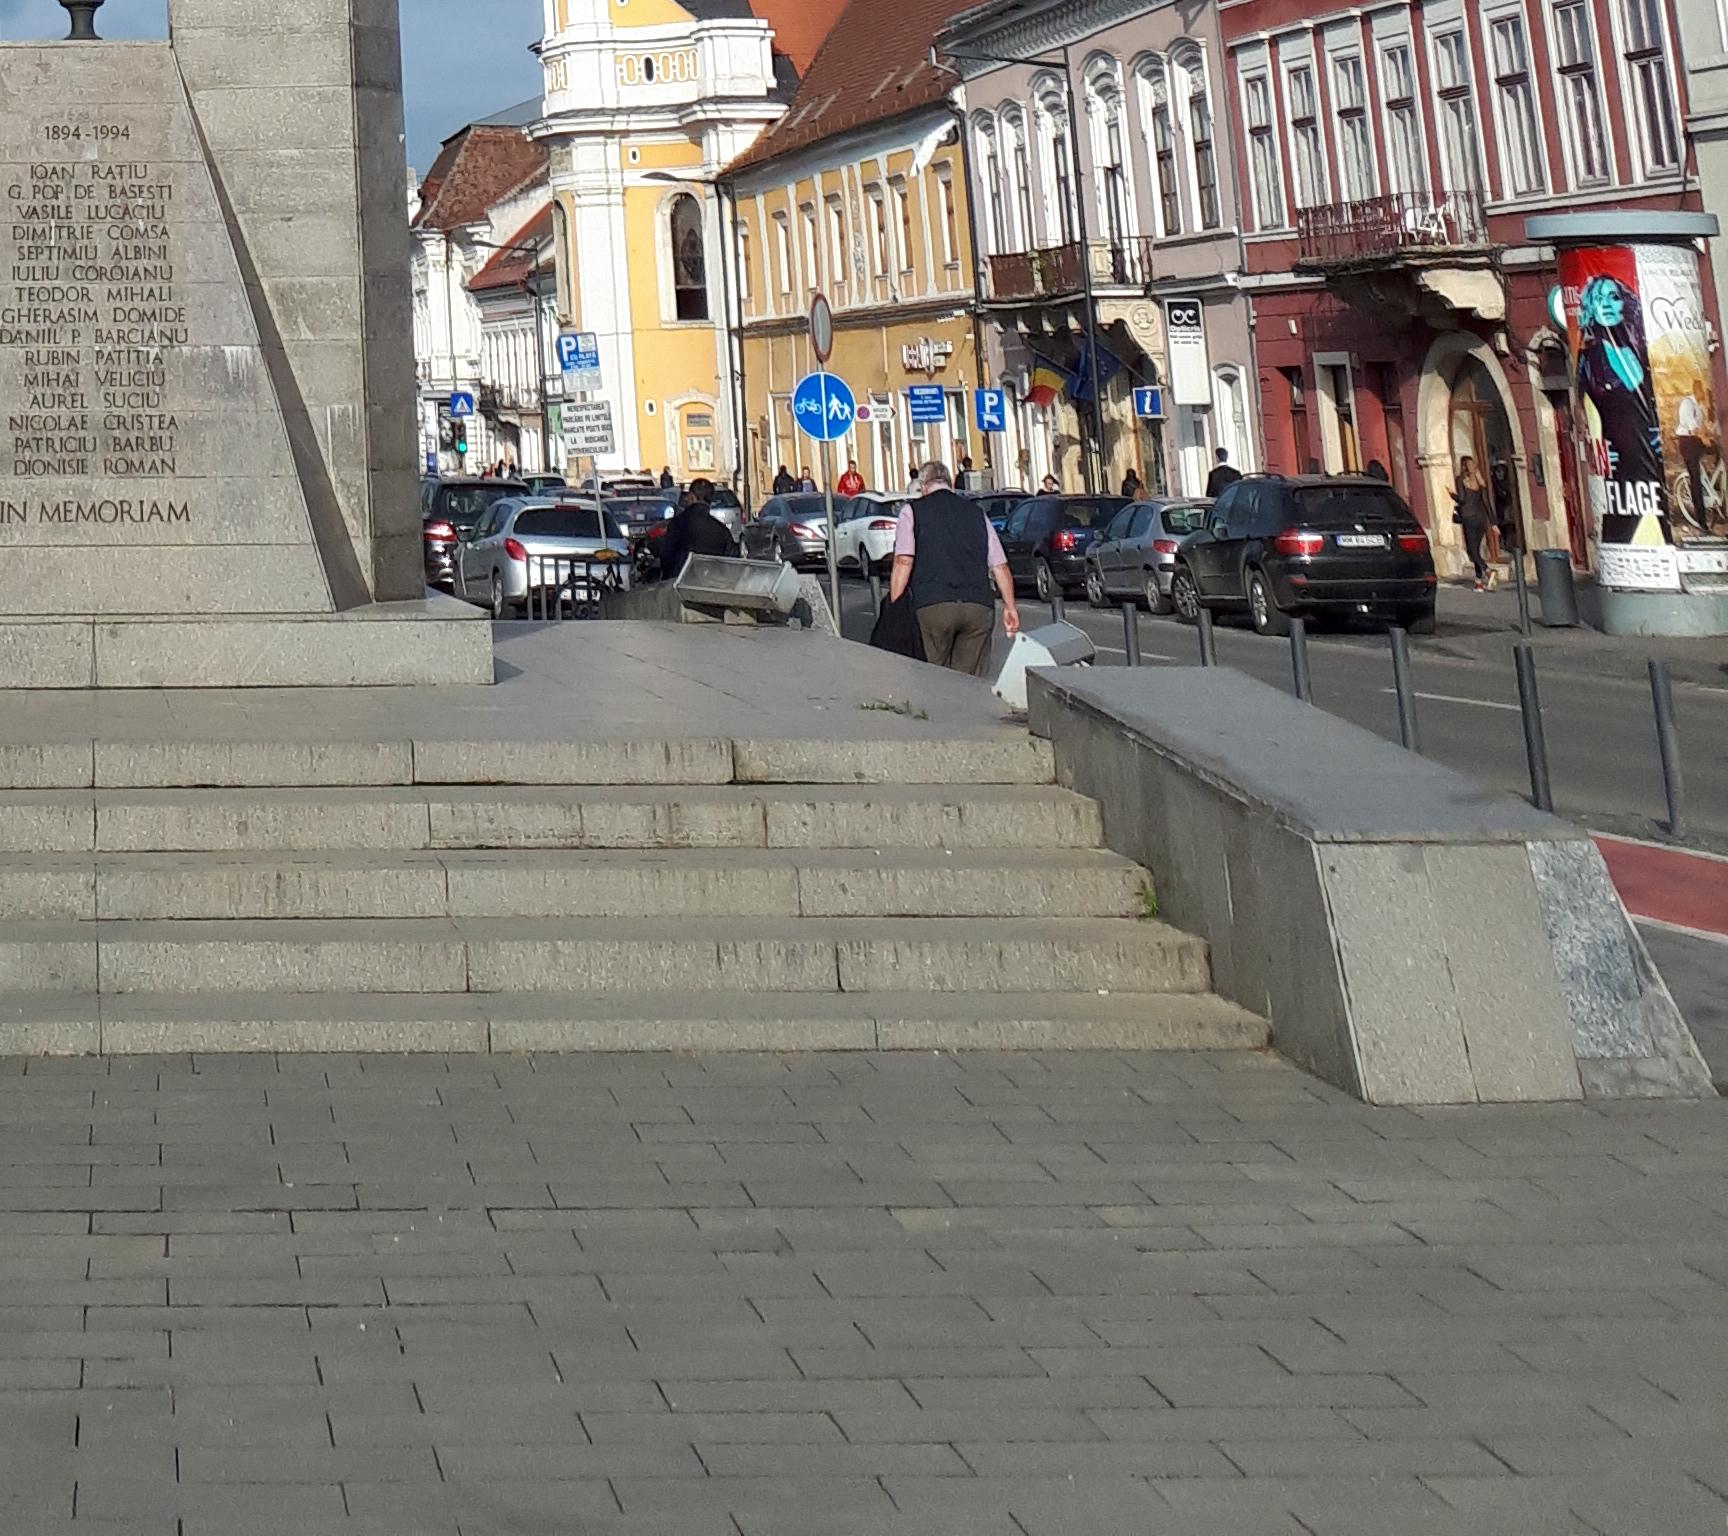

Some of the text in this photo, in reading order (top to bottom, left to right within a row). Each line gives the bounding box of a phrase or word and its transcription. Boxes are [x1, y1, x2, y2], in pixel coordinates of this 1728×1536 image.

[30, 163, 76, 180] IOAN
[74, 184, 95, 200] DE
[16, 204, 165, 220] VASILE LUCACIU
[12, 225, 94, 241] DIMITRIE
[17, 244, 167, 261] SEPTIMIU ALBINI
[12, 264, 173, 281] IULIU COROIANU
[15, 286, 172, 303] TEODOR MIHALI
[1, 307, 187, 324] GHERASIM DOMIDE
[0, 328, 60, 344] DANIIL
[94, 328, 189, 344] BARCIANU
[25, 349, 164, 366] RUBIN PATITIA
[560, 336, 576, 362] P
[24, 370, 166, 388] MIHAI VELICIU
[29, 392, 160, 410] AUREL SUCIU
[984, 392, 999, 414] P
[9, 414, 179, 432] NICOLAE CRISTEA
[14, 435, 174, 454] PATRICIU BARBU
[13, 457, 176, 476] DIONISIE ROMAN
[0, 499, 191, 524] IN MEMORIAM
